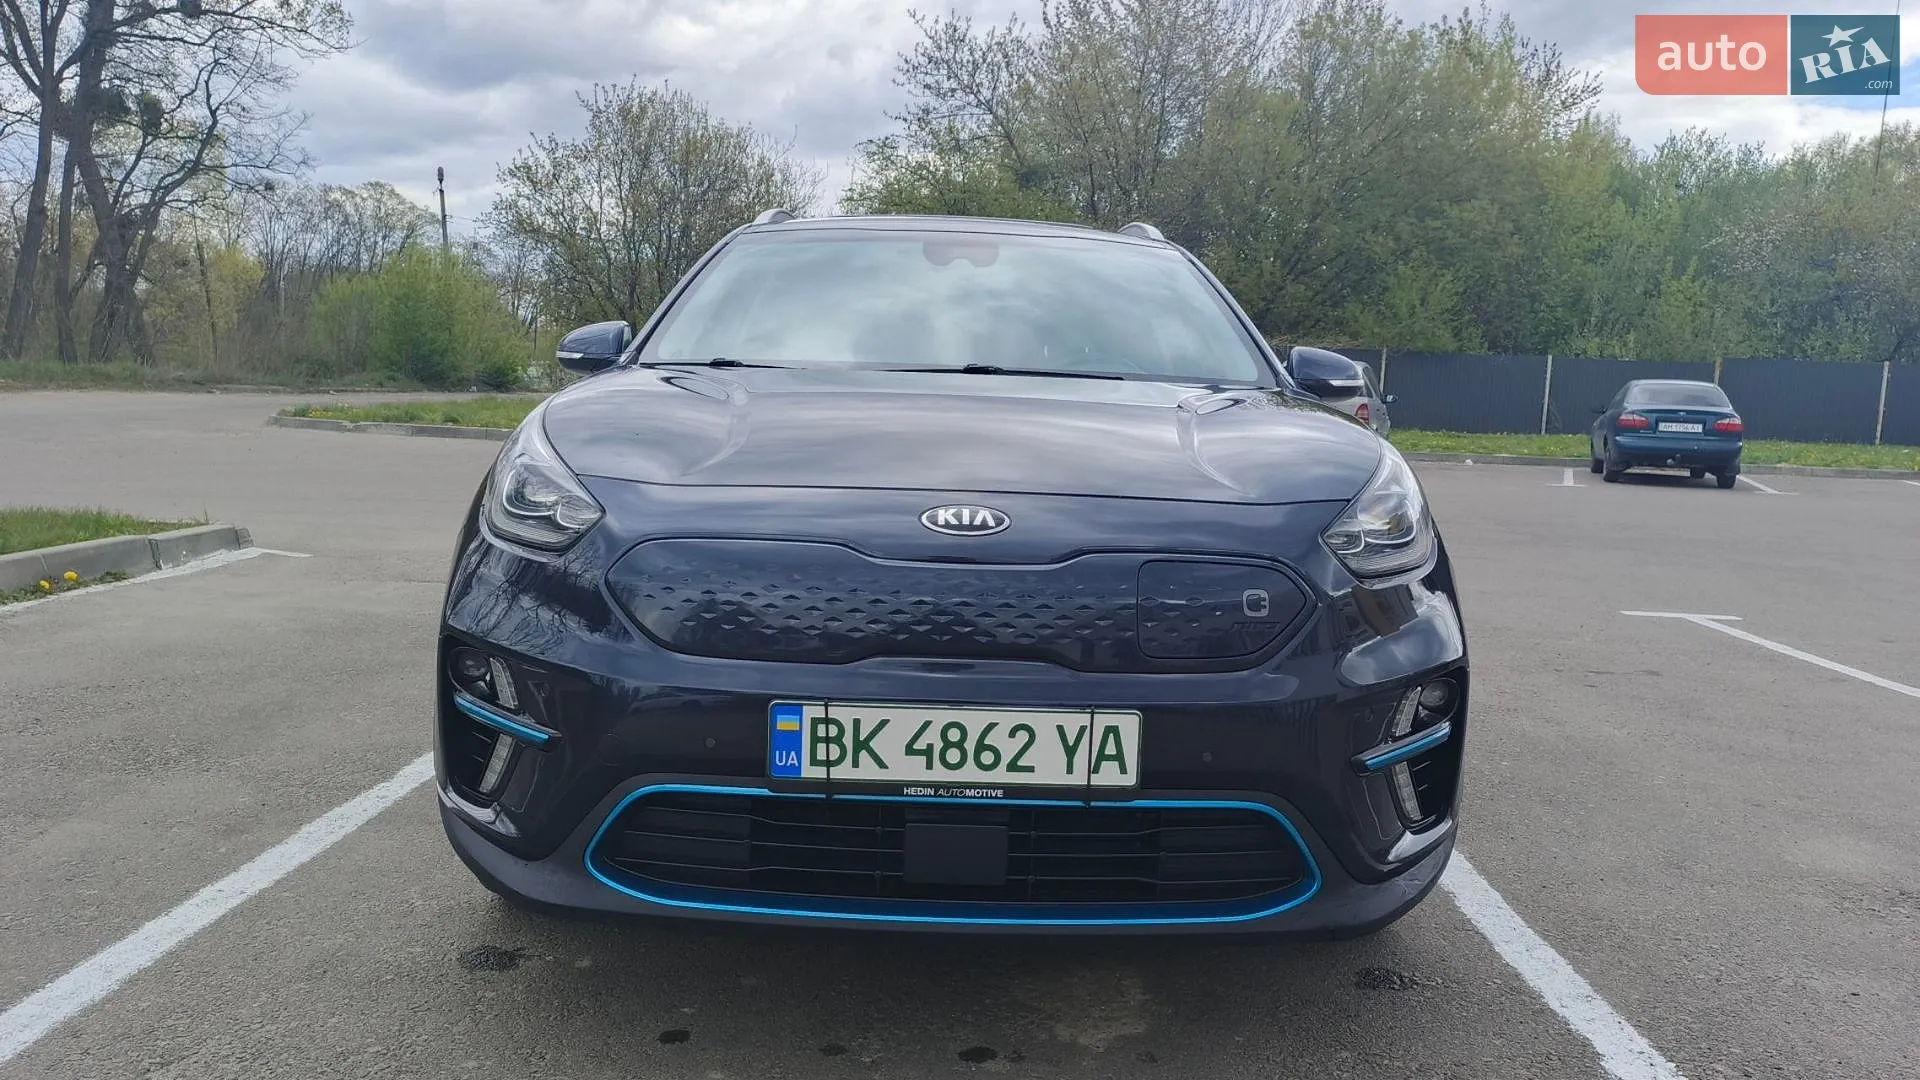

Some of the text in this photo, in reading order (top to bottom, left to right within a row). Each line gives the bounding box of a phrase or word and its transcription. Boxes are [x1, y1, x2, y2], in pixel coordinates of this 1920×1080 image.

[937, 508, 996, 527] KIA
[809, 716, 1128, 775] BK 4862 YA
[775, 750, 799, 767] UA
[903, 787, 1004, 798] HEDIN AUTOMOTIVE
